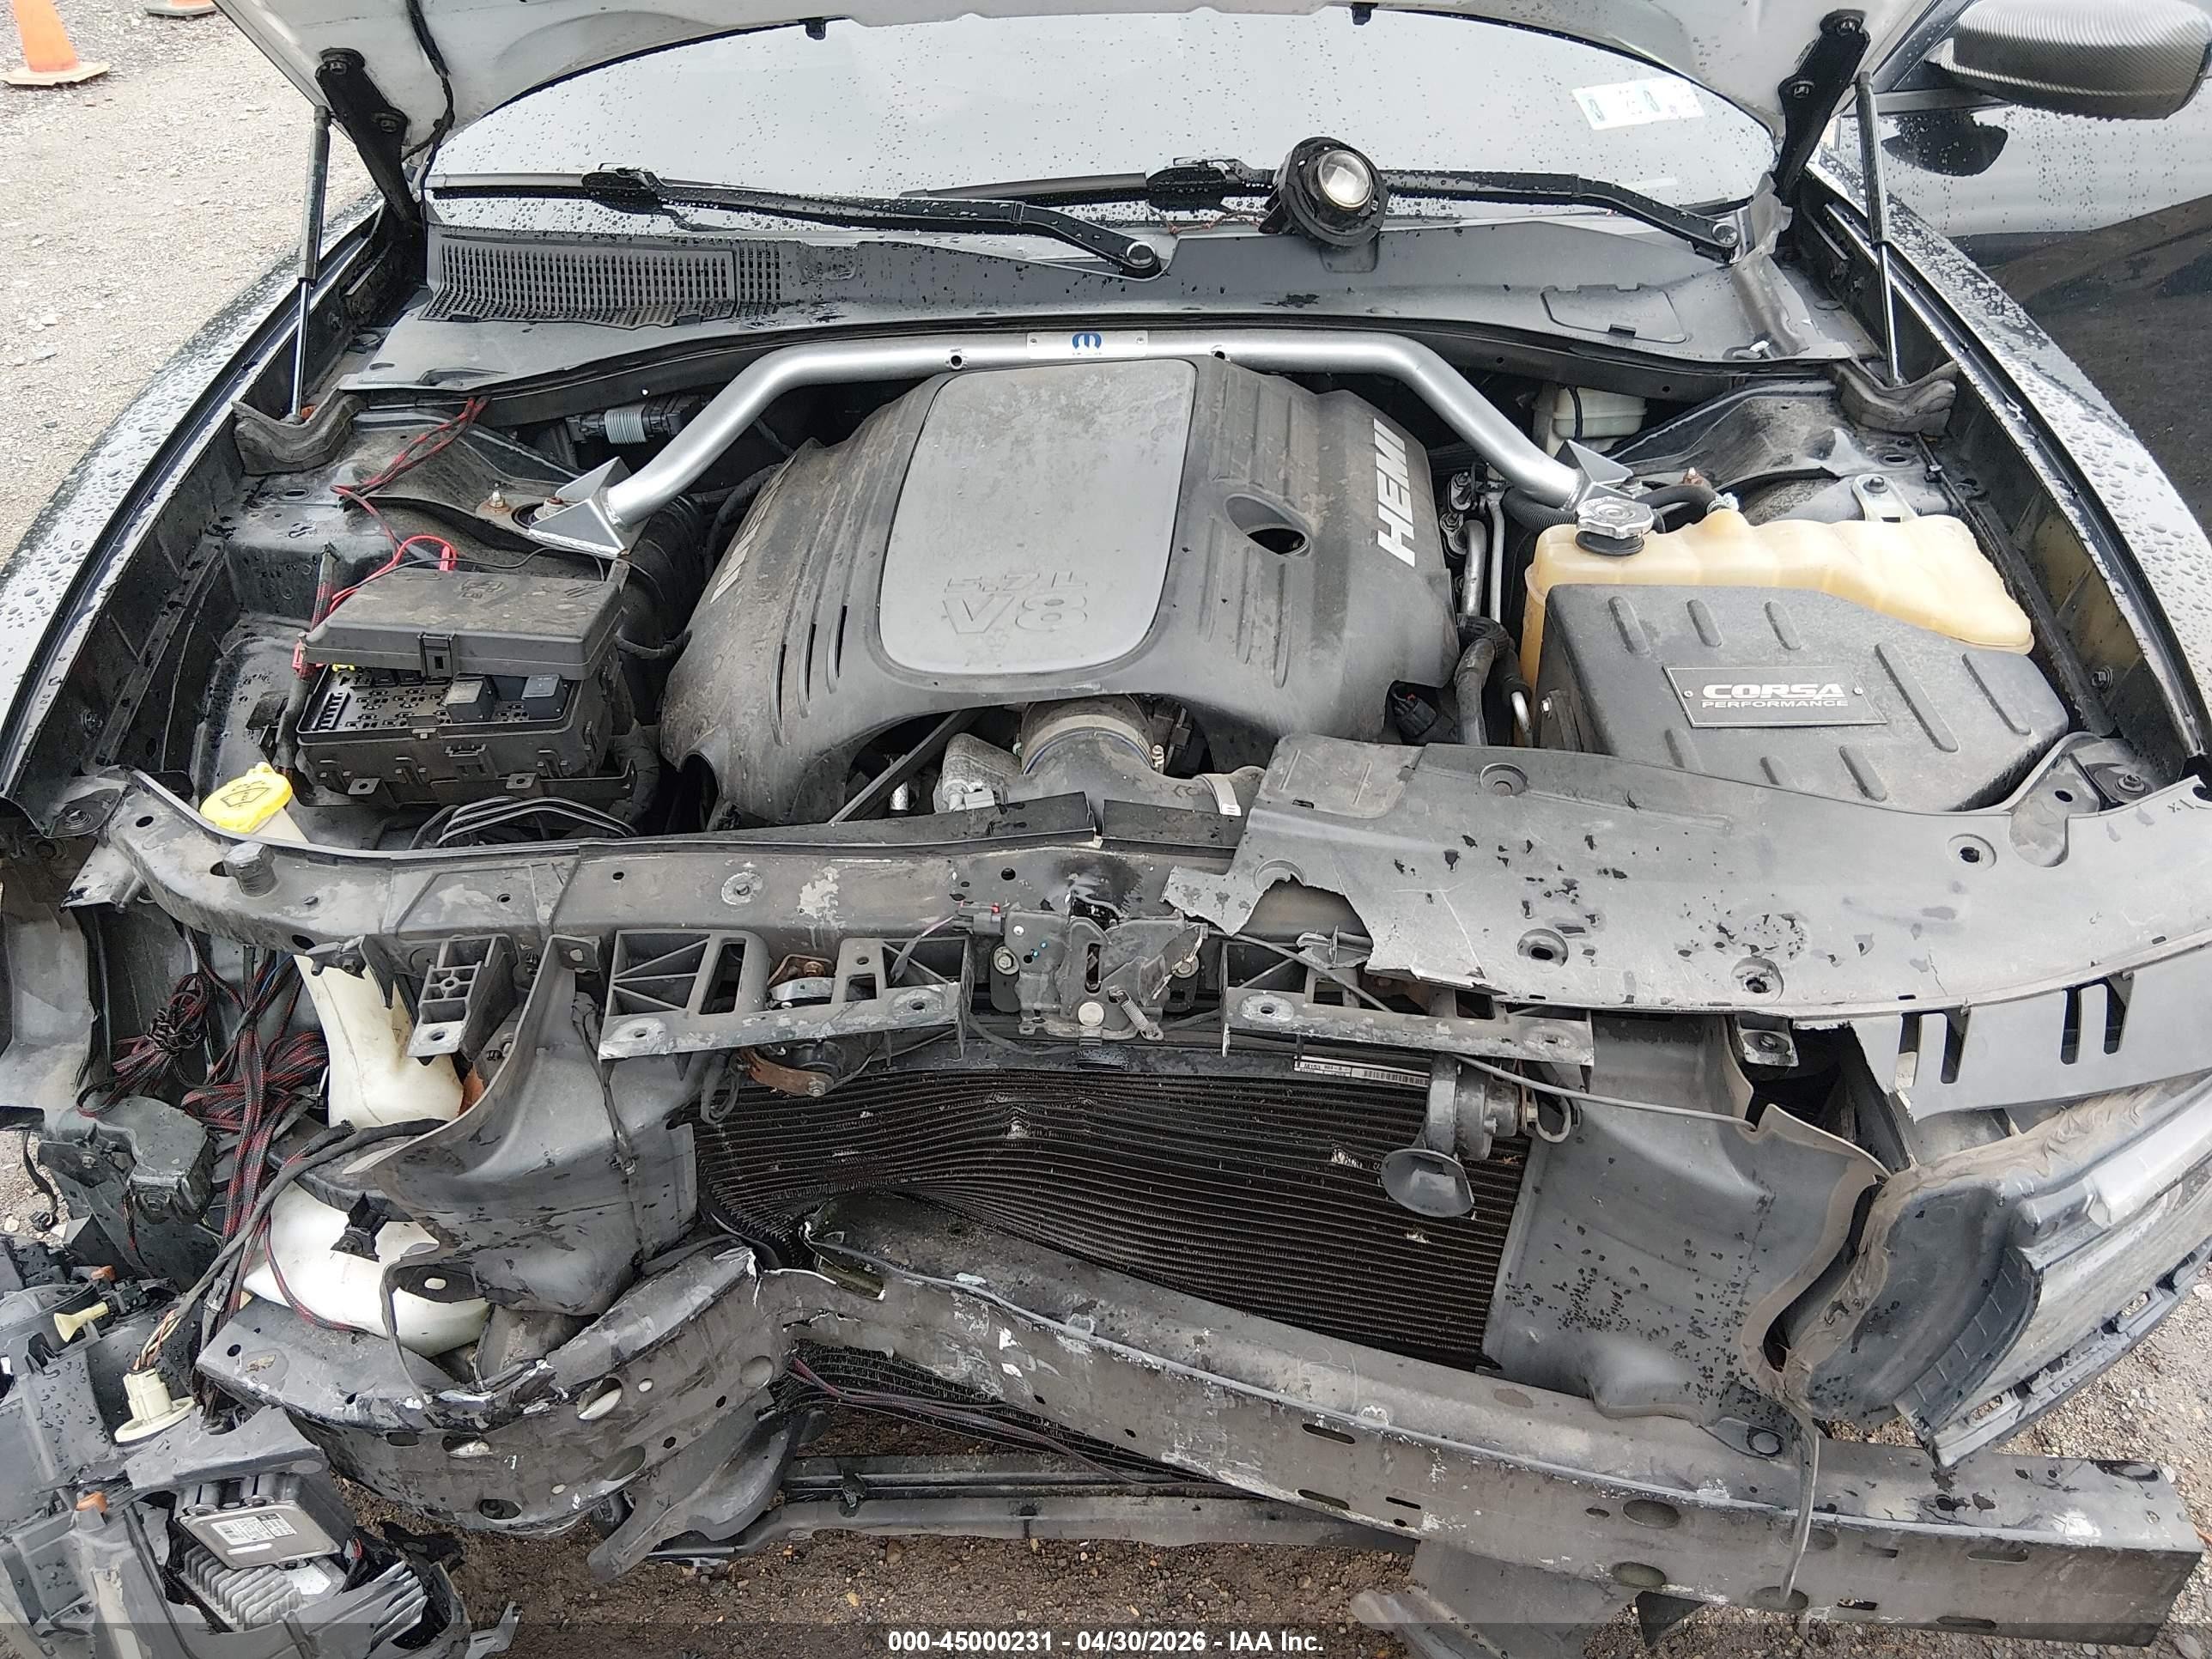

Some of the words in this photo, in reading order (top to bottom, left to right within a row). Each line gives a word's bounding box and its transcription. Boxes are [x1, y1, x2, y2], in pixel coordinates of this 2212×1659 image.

[1373, 417, 1416, 568] HEMI
[942, 594, 1088, 634] V8
[1701, 700, 1849, 708] PERFORMANCE
[1702, 684, 1845, 700] CORSA
